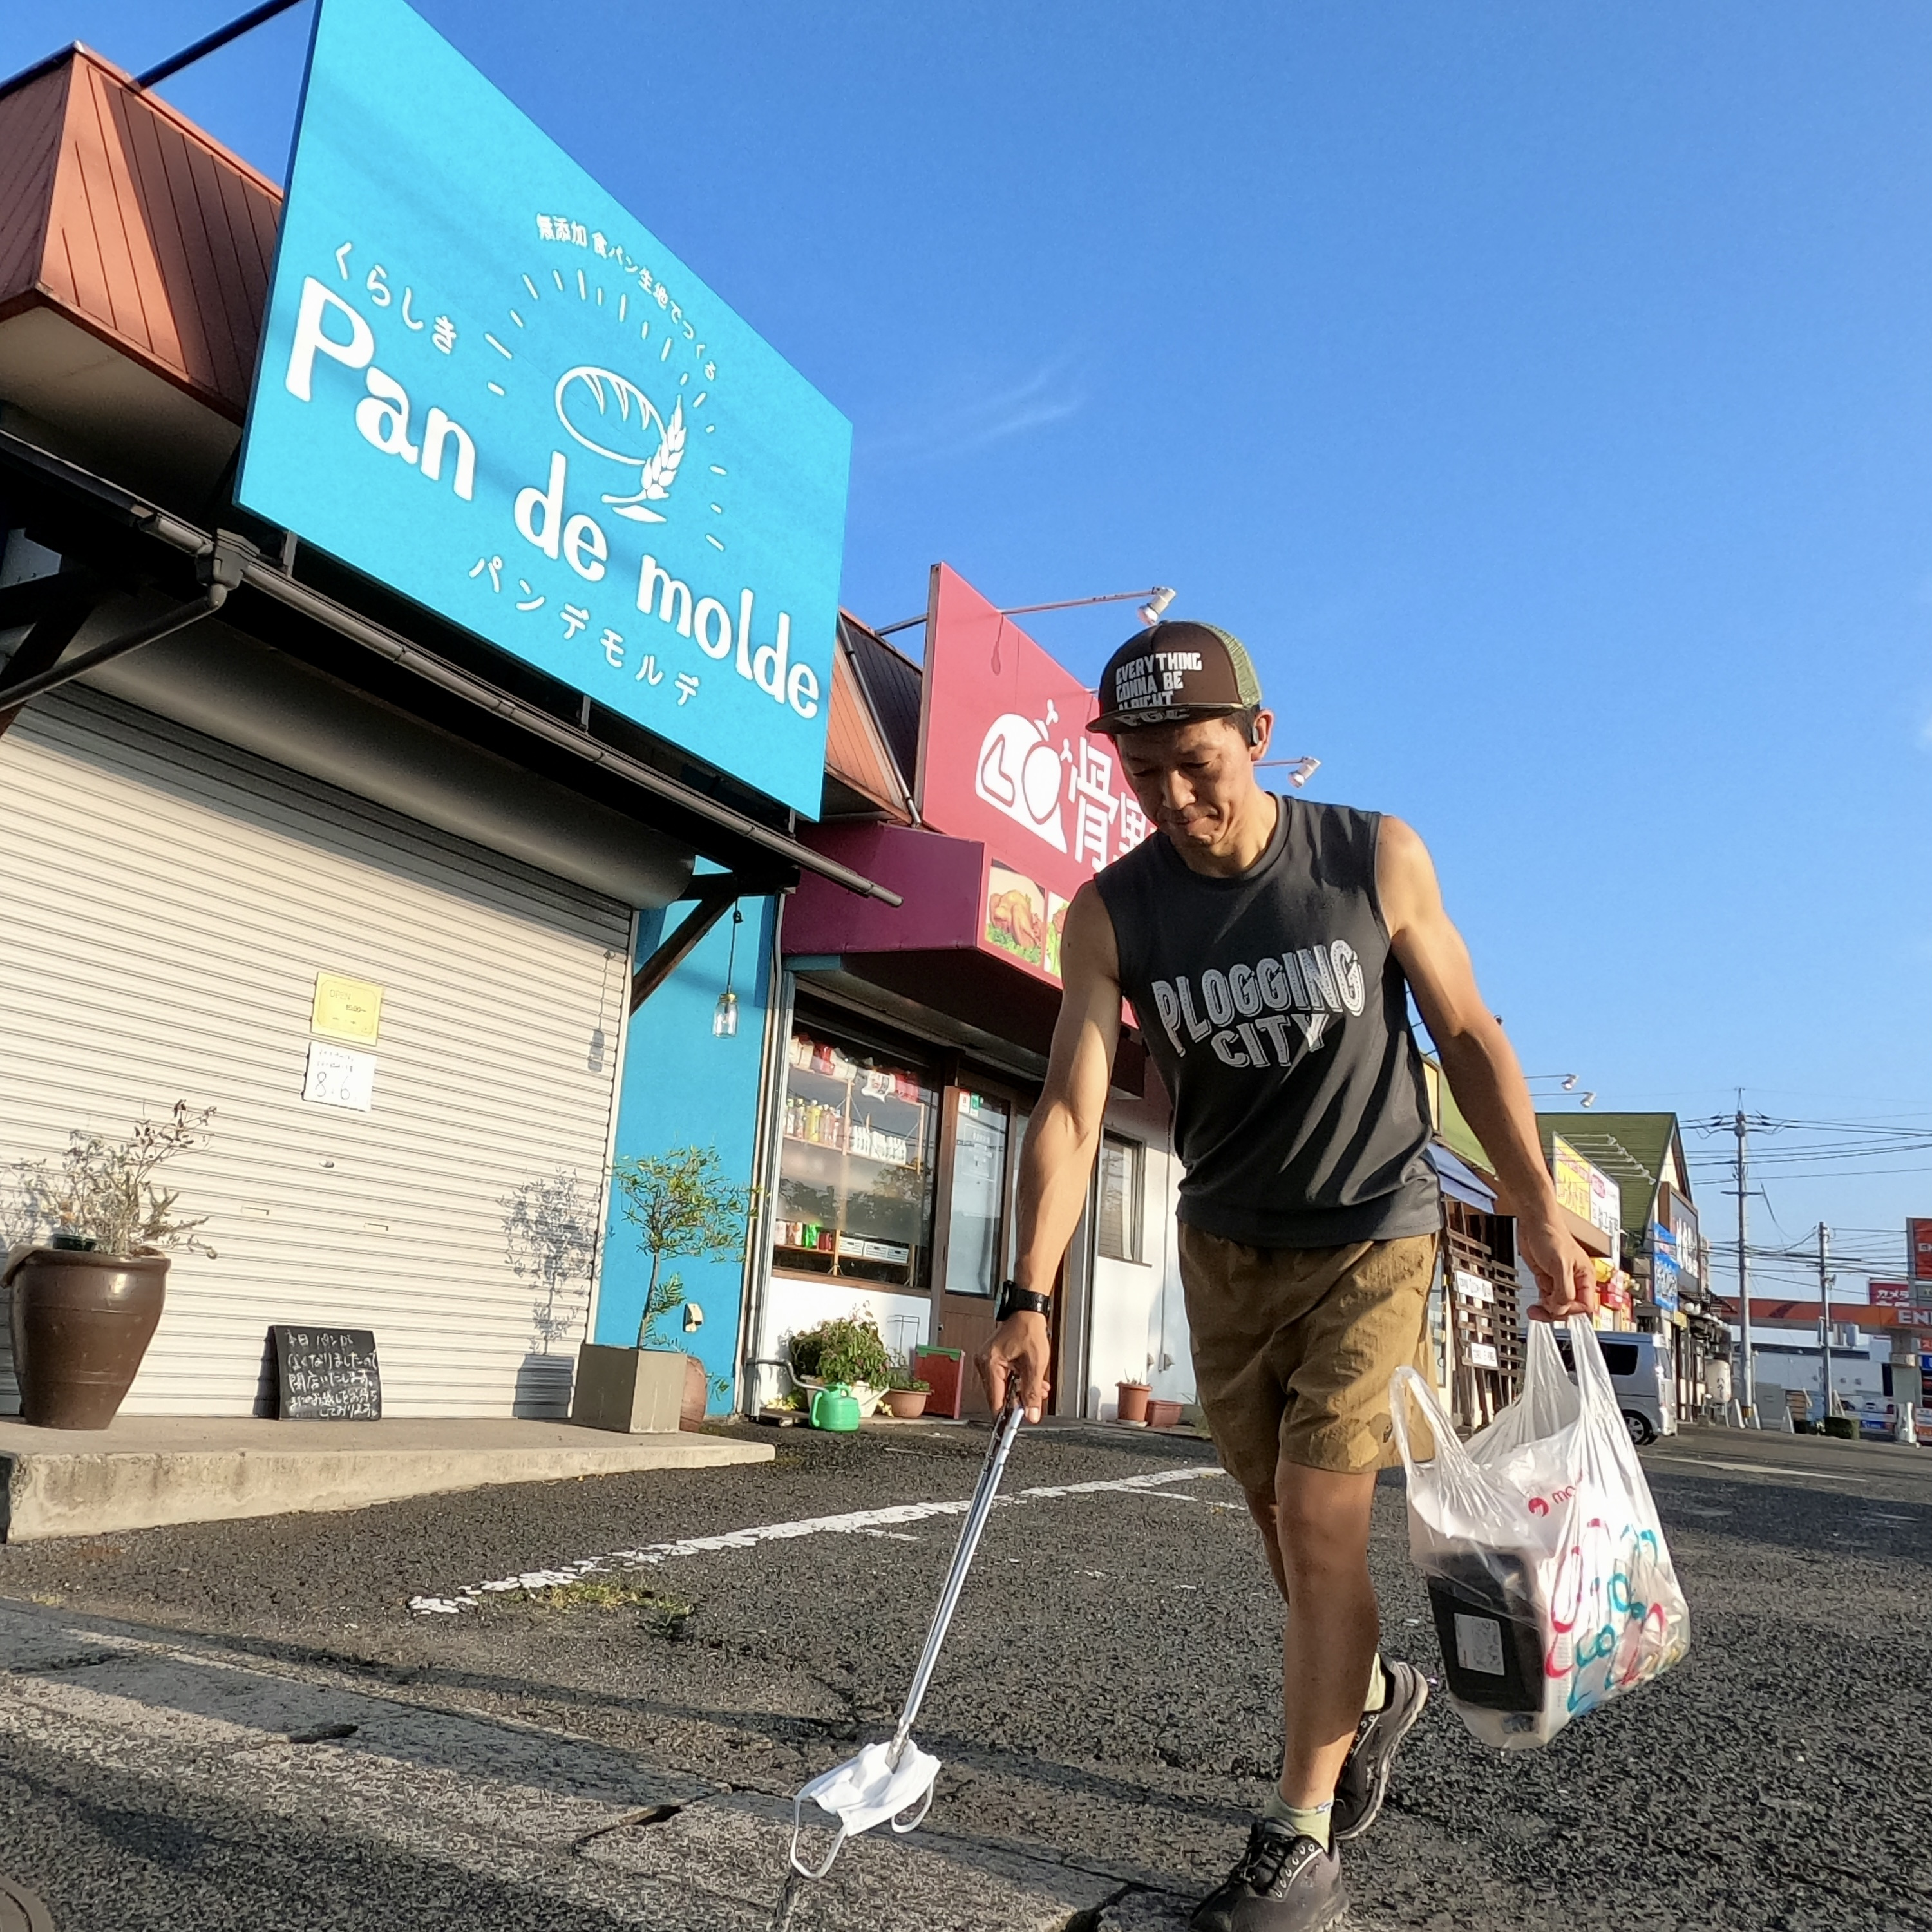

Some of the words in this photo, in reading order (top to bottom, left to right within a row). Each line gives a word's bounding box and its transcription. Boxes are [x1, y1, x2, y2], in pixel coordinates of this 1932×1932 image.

[335, 242, 457, 355] くらしき
[285, 276, 476, 502] Pan
[513, 451, 608, 581] de
[636, 554, 819, 719] molde
[469, 556, 700, 706] パンデモルデ
[1116, 675, 1158, 703] GONNA
[1162, 670, 1184, 690] BE
[1151, 940, 1365, 1057] PLOGGING
[1211, 1013, 1329, 1068] CITY
[1898, 1309, 1932, 1325] EN
